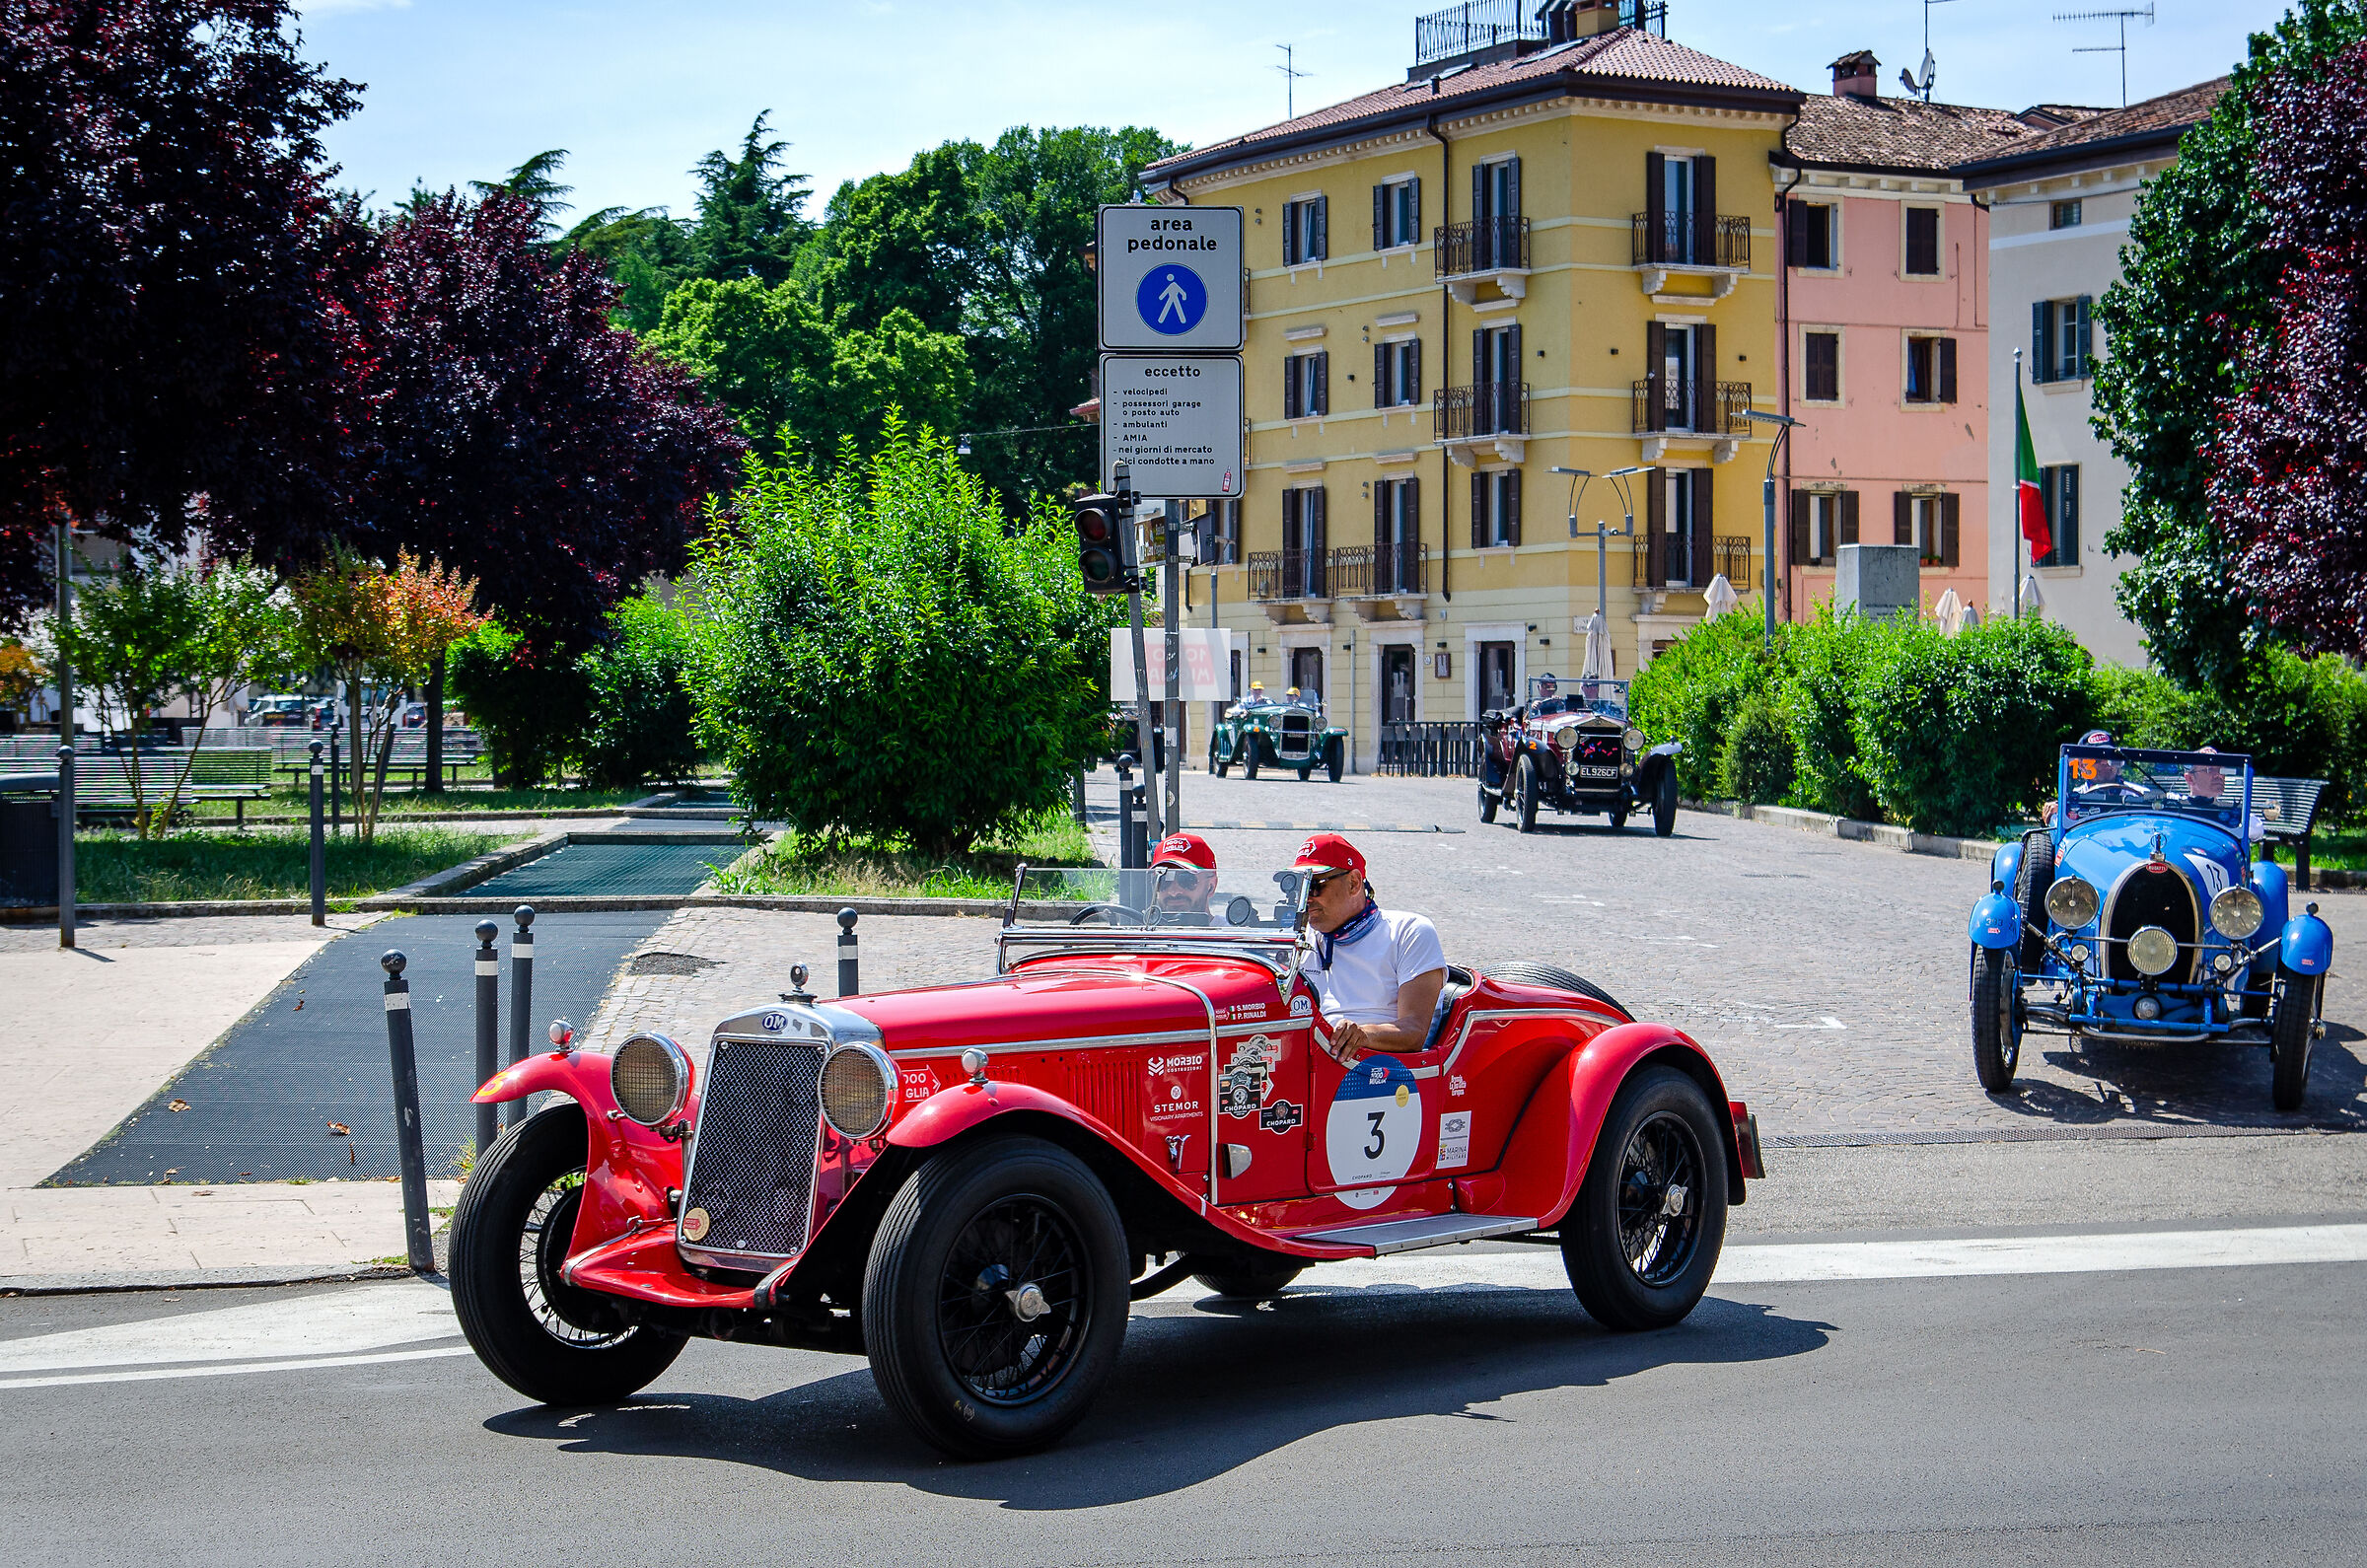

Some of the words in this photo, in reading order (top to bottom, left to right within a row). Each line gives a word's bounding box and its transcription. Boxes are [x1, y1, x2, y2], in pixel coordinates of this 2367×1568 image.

[1150, 217, 1193, 232] area
[1127, 236, 1218, 253] pedonale
[1144, 365, 1201, 378] eccetto
[1122, 388, 1168, 398] velocipedi
[1122, 399, 1169, 410] possessori
[1172, 401, 1201, 410] garage
[1131, 408, 1156, 419] posto
[1122, 420, 1168, 429] ambulanti
[1118, 445, 1133, 454] nei
[1134, 445, 1162, 456] giorni
[1164, 445, 1173, 454] di
[1137, 457, 1181, 465] condotte
[1529, 741, 1538, 749] 2
[1581, 767, 1616, 777] EL926CF
[2068, 758, 2098, 780] 13
[2205, 864, 2224, 891] 13
[1293, 1000, 1310, 1011] OM
[763, 1014, 785, 1029] OM
[1166, 1055, 1203, 1068] MORBIO
[1154, 1101, 1199, 1113] STEMOR
[1224, 1104, 1257, 1112] CHOPARD
[1266, 1118, 1297, 1127] CHOPARD
[1364, 1110, 1386, 1160] 3
